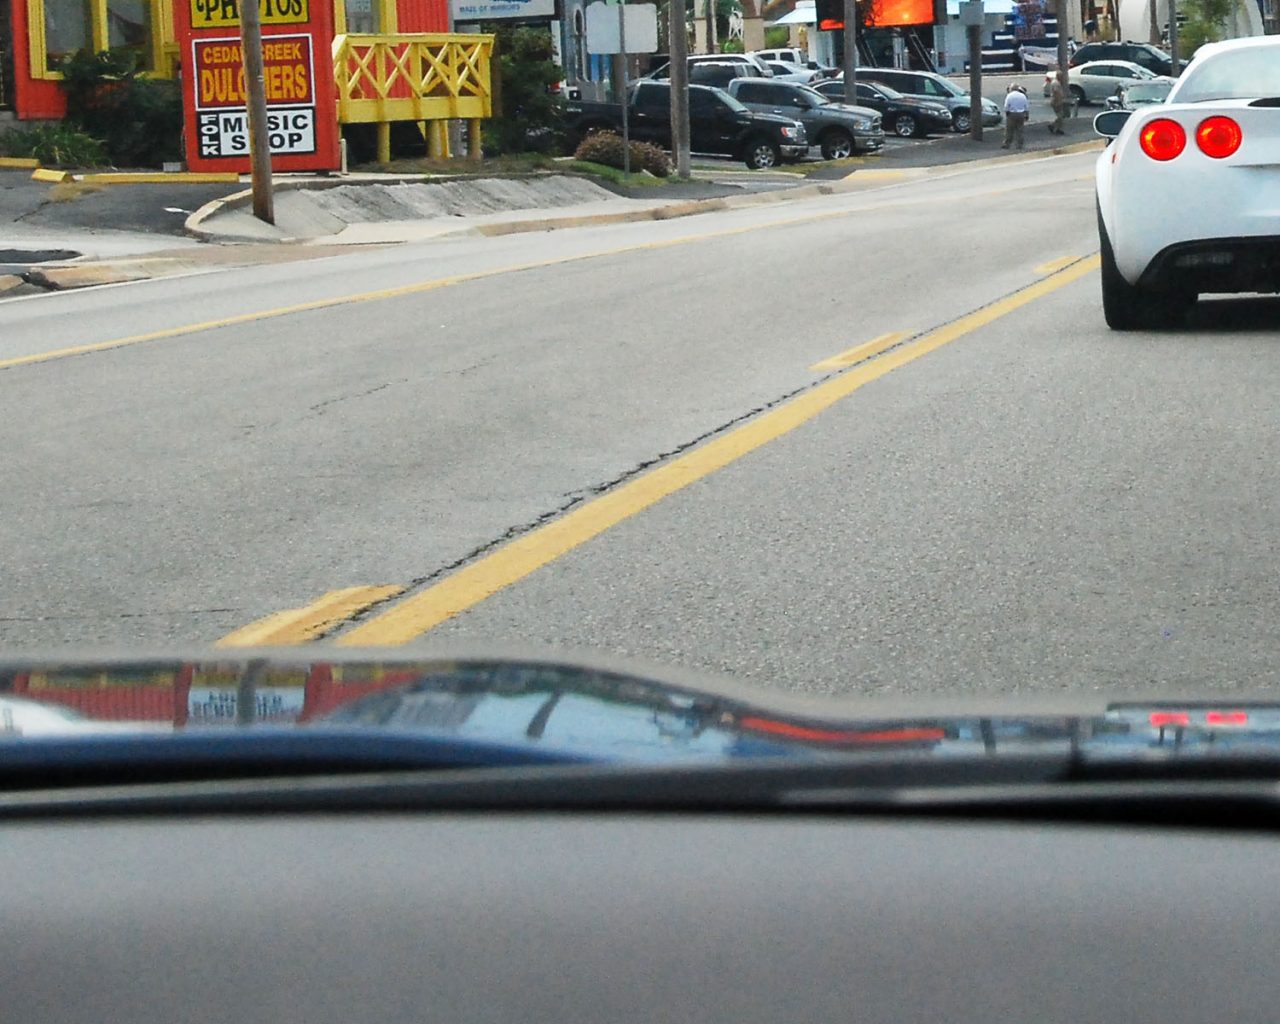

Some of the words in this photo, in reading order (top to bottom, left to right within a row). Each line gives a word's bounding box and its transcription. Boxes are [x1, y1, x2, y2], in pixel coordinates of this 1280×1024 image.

[203, 46, 243, 65] CEDA
[201, 63, 309, 102] DULCERS
[223, 114, 309, 134] MSIC
[200, 114, 219, 156] FOLK
[231, 132, 303, 151] SOP
